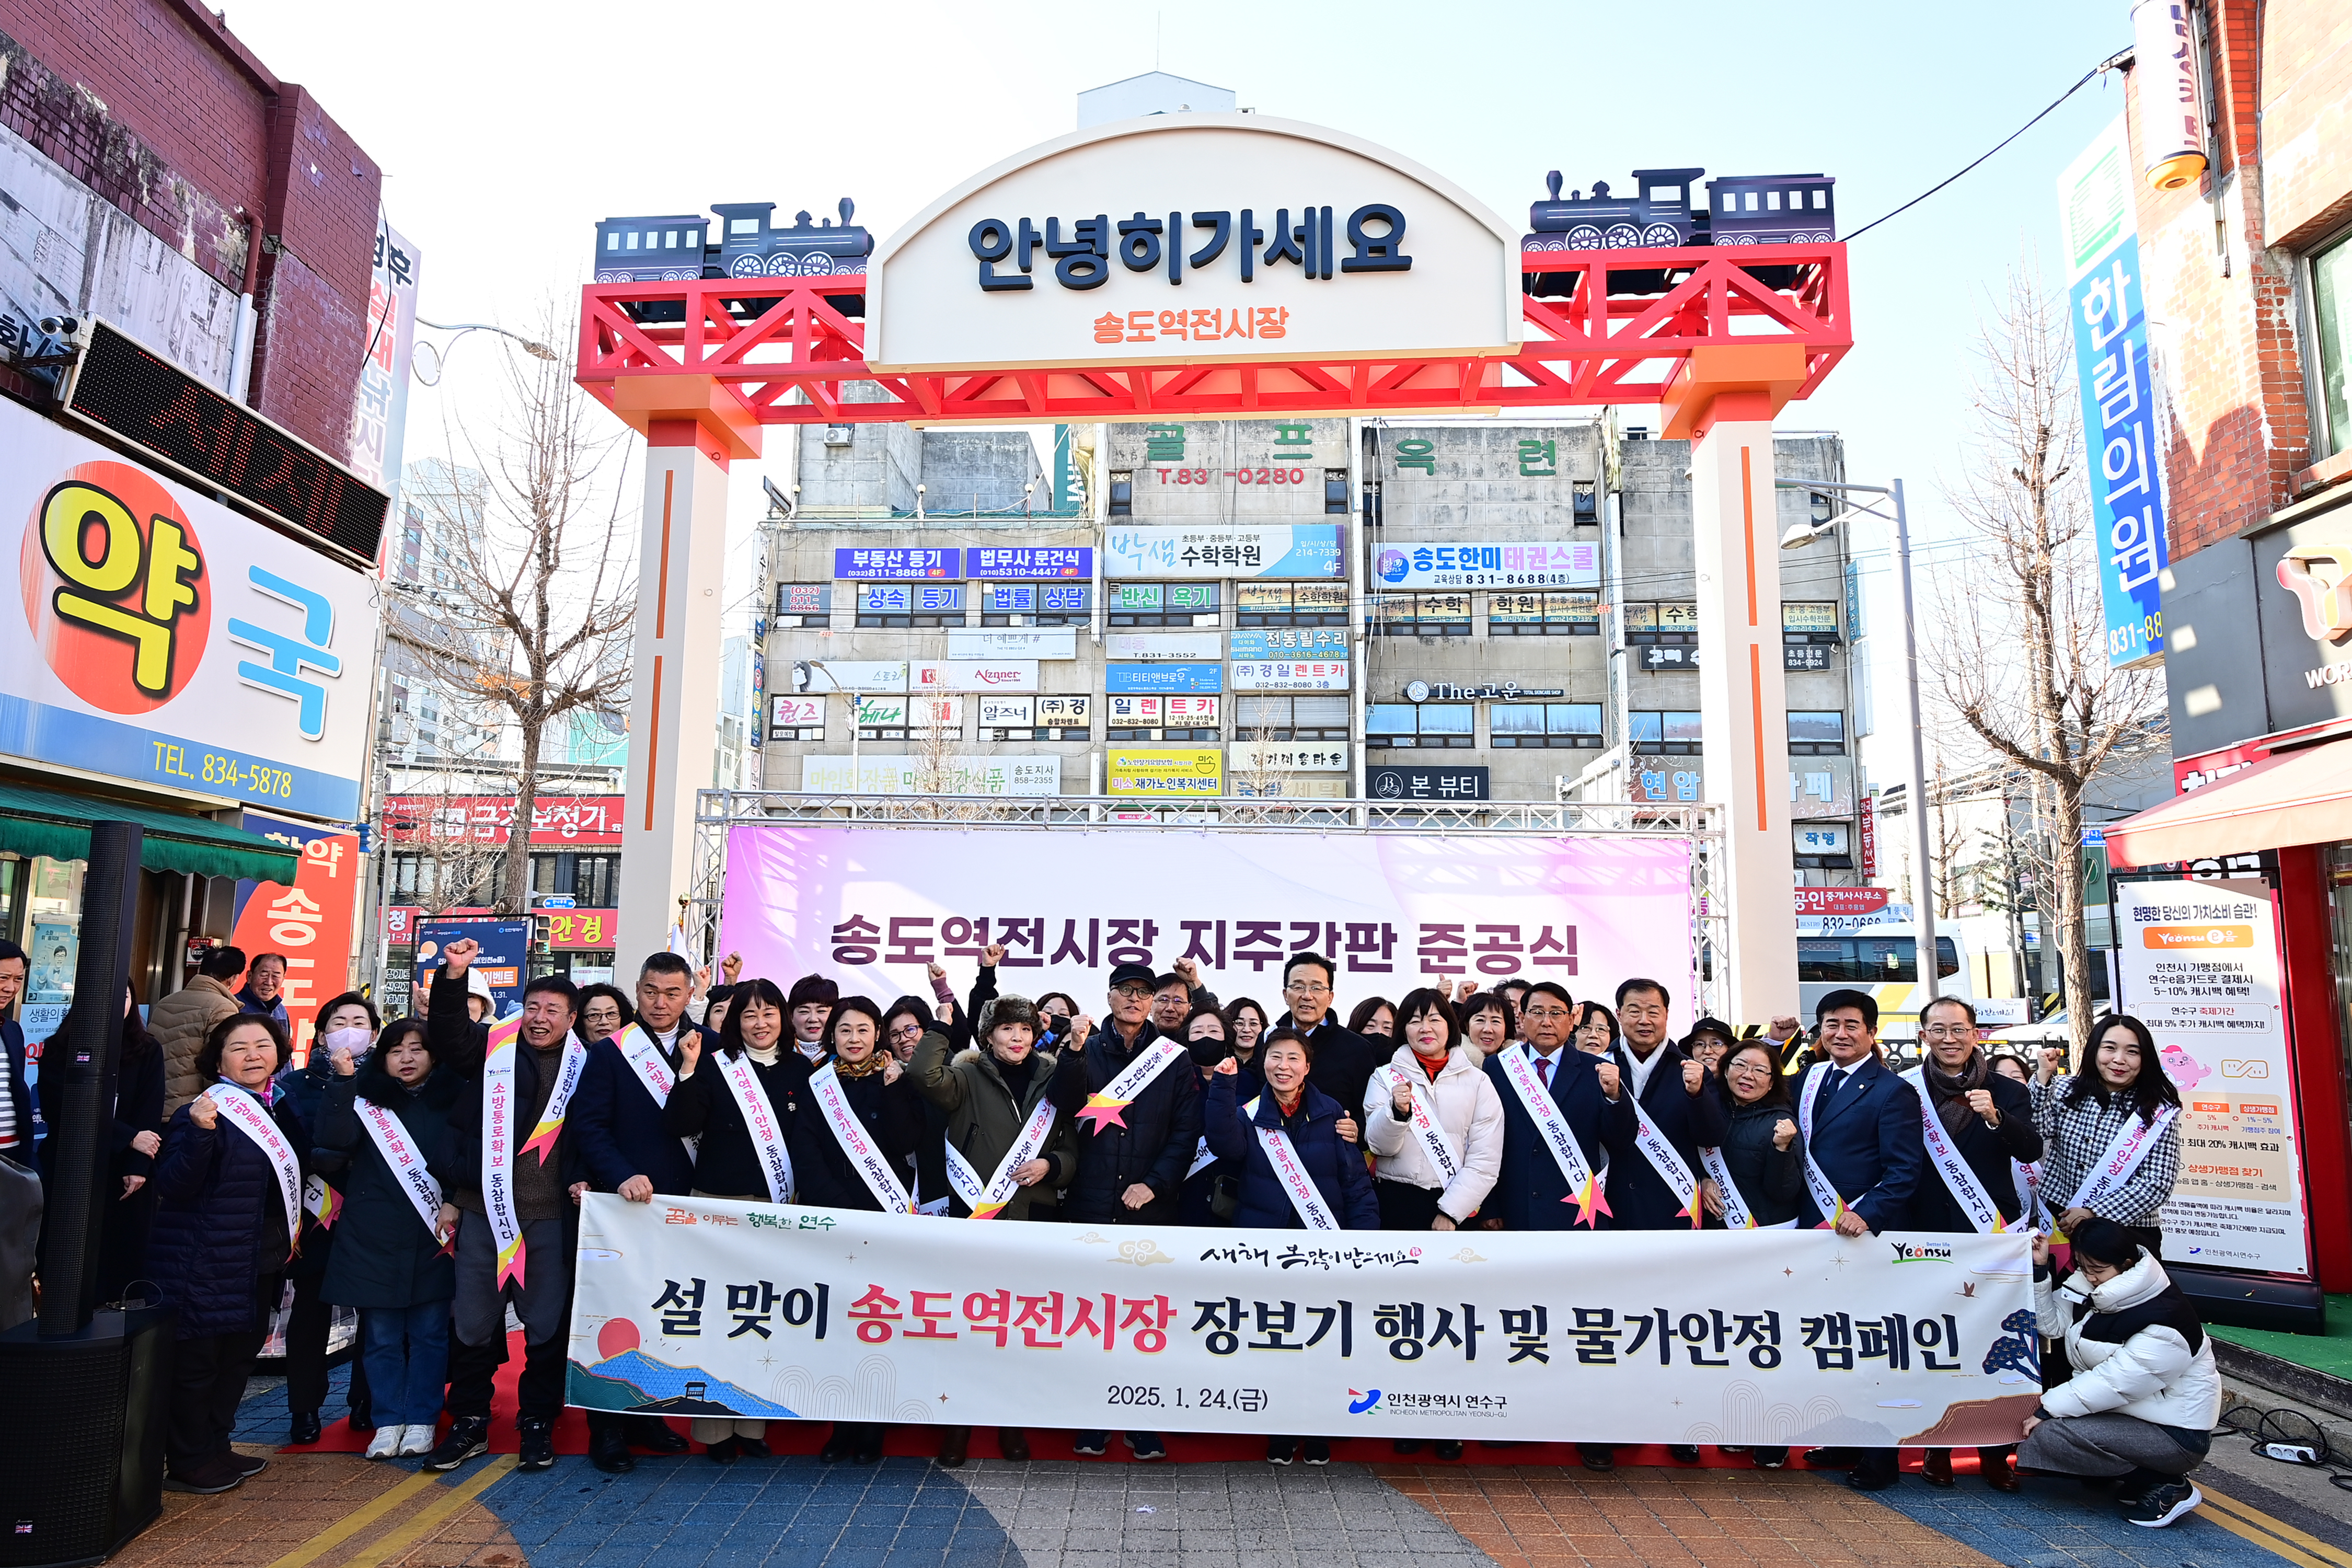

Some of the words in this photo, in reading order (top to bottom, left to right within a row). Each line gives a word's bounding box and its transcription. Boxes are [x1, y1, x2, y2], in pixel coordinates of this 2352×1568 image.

[968, 203, 1412, 292] 안녕히가세요
[1093, 306, 1289, 344] 송도역전시장
[2081, 259, 2158, 592] 한림의원
[1147, 424, 1186, 462] 골
[1272, 424, 1313, 460] 프
[1395, 439, 1435, 476] 옥
[1518, 439, 1556, 476] 련
[852, 550, 904, 568] 부동산
[908, 550, 942, 568] 등기
[980, 549, 1031, 567] 법무사
[1034, 550, 1080, 567] 문건식
[1180, 546, 1261, 567] 수학학원
[847, 569, 926, 577] (032)811-8866
[980, 568, 1058, 576] (010)5310-4447
[1323, 560, 1341, 573] 4F
[1434, 574, 1462, 584] 교육상담
[790, 586, 820, 595] (032)
[867, 587, 906, 609] 상속
[921, 587, 959, 610] 등기
[994, 586, 1032, 610] 법률
[1045, 586, 1086, 610] 상담
[1121, 587, 1159, 608] 반신
[1172, 586, 1211, 608] 욕기
[1299, 592, 1343, 603] 수학학원
[40, 480, 342, 741] 약국
[1423, 595, 1463, 614] 수학
[1495, 595, 1535, 614] 학원
[997, 633, 1029, 644] 예쁘게
[1265, 630, 1347, 648] 전동릴수리
[1788, 650, 1823, 658] 초등전문
[872, 670, 902, 682] 스토리
[1132, 672, 1185, 683] 티티앤브로우
[1433, 682, 1475, 700] The
[1479, 681, 1521, 702] 고운
[984, 705, 1027, 721] 알즈너
[1041, 699, 1065, 714] (주)
[153, 741, 194, 780] TEL.
[201, 753, 292, 798] 834-5878
[1014, 765, 1054, 775] 송도지사
[1112, 777, 1133, 790] 미소
[1135, 777, 1217, 791] 재가노인복지센터
[1410, 775, 1431, 798] 본
[1437, 775, 1479, 798] 뷰티
[1640, 771, 1701, 801] 현암
[1805, 832, 1835, 846] 작명
[1825, 891, 1882, 902] 중개사사무소
[2132, 905, 2161, 922] 현명한
[2163, 904, 2191, 921] 당신의
[2194, 904, 2232, 920] 가치소비
[2233, 903, 2257, 919] 습관!
[550, 914, 602, 943] 안경
[829, 916, 1155, 969] 송도역전시장
[1417, 923, 1578, 976] 준공식
[2157, 932, 2205, 945] Yeonsu
[2155, 963, 2187, 973] 인천시
[2190, 962, 2243, 972] 가맹점에서
[2148, 974, 2218, 984] 연수e음카드로
[2220, 974, 2254, 985] 결제시
[2153, 986, 2187, 996] 5~10%
[2190, 986, 2222, 996] 캐시백
[2225, 986, 2250, 996] 혜택!
[29, 1008, 60, 1024] 생활의
[2171, 1007, 2197, 1015] 연수구
[2199, 1007, 2235, 1016] 축제기간
[2146, 1019, 2163, 1028] 최대
[2164, 1019, 2177, 1028] 5%
[2178, 1020, 2196, 1029] 추가
[2198, 1020, 2224, 1029] 캐시백
[2227, 1020, 2265, 1030] 혜택까지!
[1115, 1051, 1163, 1101] 동참합시다
[490, 1080, 506, 1169] 소방통로확보
[1507, 1054, 1552, 1119] 지역물가안정
[1545, 1119, 1587, 1184] 동참합시다
[732, 1066, 775, 1143] 지역물가안정
[765, 1144, 791, 1204] 동참합시다
[821, 1083, 868, 1156] 지역물가안정
[863, 1155, 908, 1214] 동참합시다
[2187, 1138, 2206, 1148] 최대
[2207, 1139, 2227, 1149] 20%
[2229, 1140, 2257, 1151] 캐시백
[2260, 1142, 2280, 1152] 효과
[223, 1094, 289, 1162] 소방통로확보
[282, 1162, 301, 1226] 동참합시다
[1262, 1127, 1311, 1201] 지역물가안정
[1646, 1137, 1694, 1198] 동참합시다
[2188, 1163, 2239, 1176] 상생가맹점
[2241, 1167, 2264, 1178] 찾기
[1942, 1159, 1996, 1226] 동참합시다
[2215, 1180, 2254, 1190] 상생가맹점
[2261, 1182, 2277, 1192] 검색
[490, 1172, 515, 1242] 동참합시다
[2223, 1204, 2243, 1213] 캐시백
[665, 1207, 697, 1225] 꿈을
[703, 1214, 739, 1226] 이루는
[746, 1211, 792, 1230] 행복한
[798, 1215, 837, 1231] 연수
[1200, 1242, 1269, 1267] 새해
[1343, 1246, 1420, 1269] 받으세요
[1891, 1241, 1952, 1262] Yeonsu
[2204, 1248, 2262, 1260] 인천광역시연수구
[651, 1277, 707, 1339] 설
[725, 1278, 831, 1341] 맞이
[847, 1282, 1178, 1353] 송도역전시장
[1191, 1296, 1355, 1359] 장보기
[1373, 1301, 1485, 1362] 행사
[1499, 1304, 1549, 1364] 및
[1567, 1307, 1782, 1370] 물가안정
[1800, 1310, 1962, 1373] 캠페인
[1107, 1385, 1166, 1408] 2025.
[1174, 1387, 1190, 1409] 1.
[1198, 1387, 1269, 1413] 24.(금)
[1387, 1392, 1461, 1409] 인천광역시
[1465, 1394, 1508, 1410] 연수구
